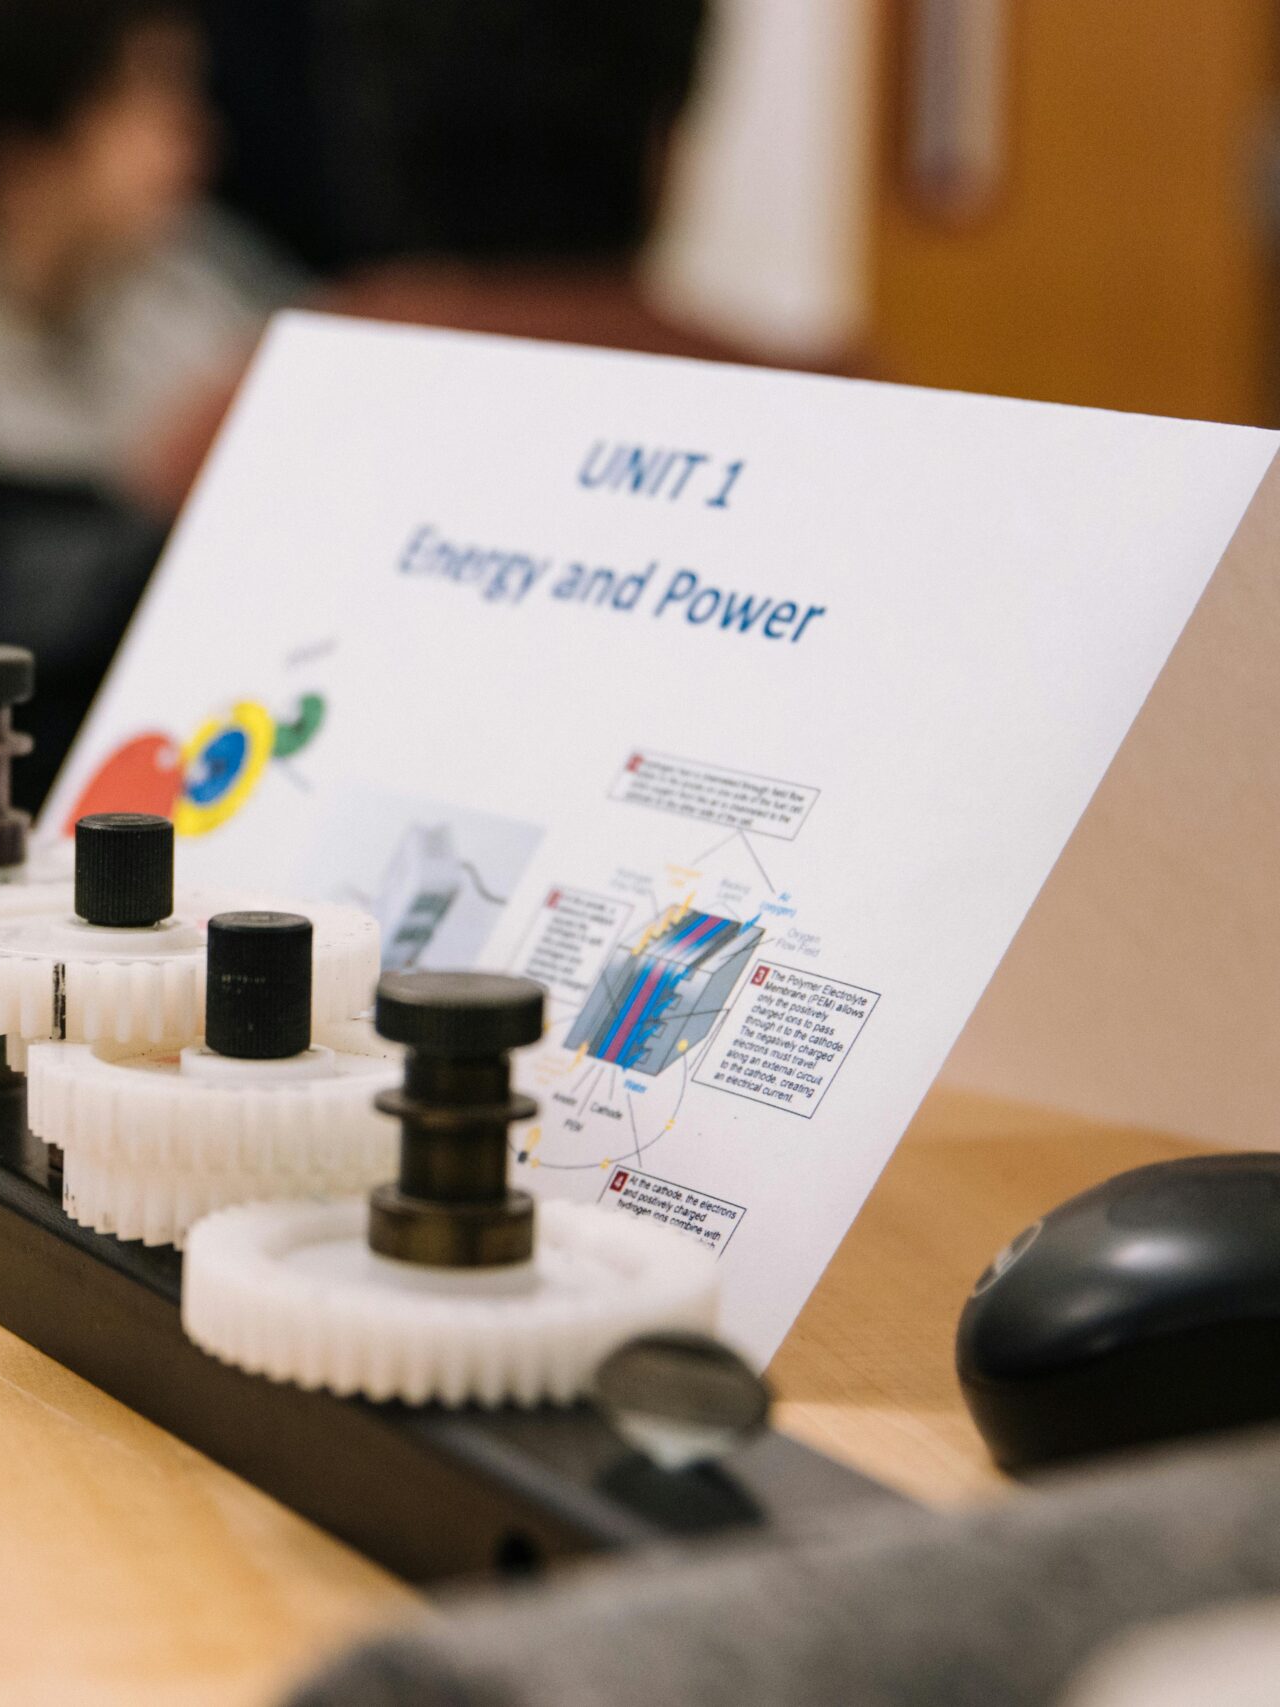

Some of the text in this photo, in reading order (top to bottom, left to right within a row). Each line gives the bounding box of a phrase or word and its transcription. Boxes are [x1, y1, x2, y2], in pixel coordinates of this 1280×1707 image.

[577, 438, 744, 509] UNIT 1
[397, 523, 827, 644] Energy and Power
[764, 981, 865, 1019] Membrane (PEM) allows
[771, 969, 785, 981] The
[787, 974, 821, 990] Polymer
[822, 984, 867, 1006] Electrolyte
[751, 1004, 835, 1036] charged ions to pass
[757, 993, 829, 1022] only the positively
[740, 1024, 835, 1062] The negatively charged
[745, 1015, 776, 1031] through
[783, 1026, 793, 1036] to
[793, 1029, 807, 1040] the
[726, 1049, 824, 1086] along an external circuit
[733, 1038, 818, 1070] electrons must travel
[713, 1071, 794, 1104] an electrical current.
[720, 1059, 729, 1069] to
[730, 1062, 744, 1074] the
[779, 1079, 816, 1098] creating
[590, 1102, 623, 1120] Cathode
[622, 1187, 707, 1223] and positively charged
[629, 1175, 639, 1186] At
[640, 1177, 651, 1190] the
[685, 1194, 699, 1206] the
[700, 1200, 738, 1220] electrons
[617, 1199, 722, 1242] hydrogen ions combine with
